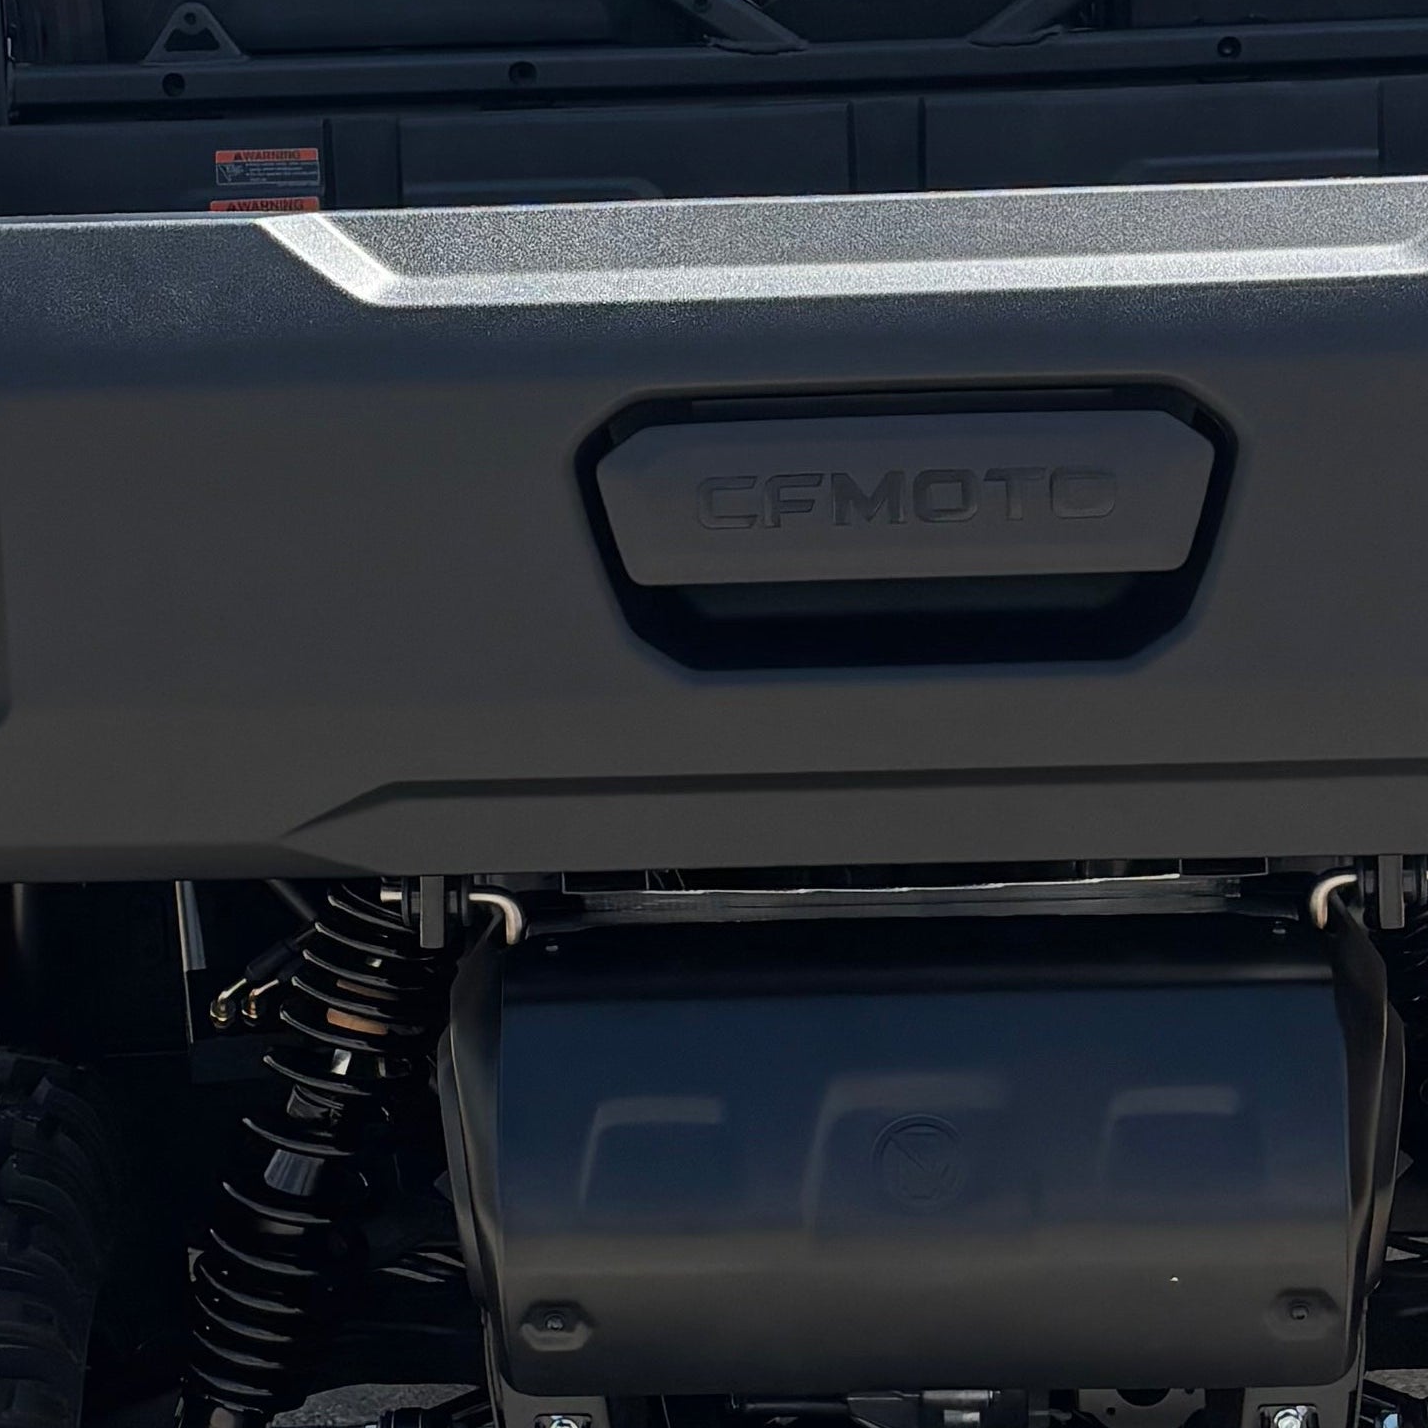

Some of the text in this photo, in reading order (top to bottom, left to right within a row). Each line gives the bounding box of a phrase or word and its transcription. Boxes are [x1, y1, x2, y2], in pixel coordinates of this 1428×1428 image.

[242, 150, 301, 161] WARNING
[236, 198, 304, 212] WARNING
[696, 464, 1118, 532] CFMOTO
